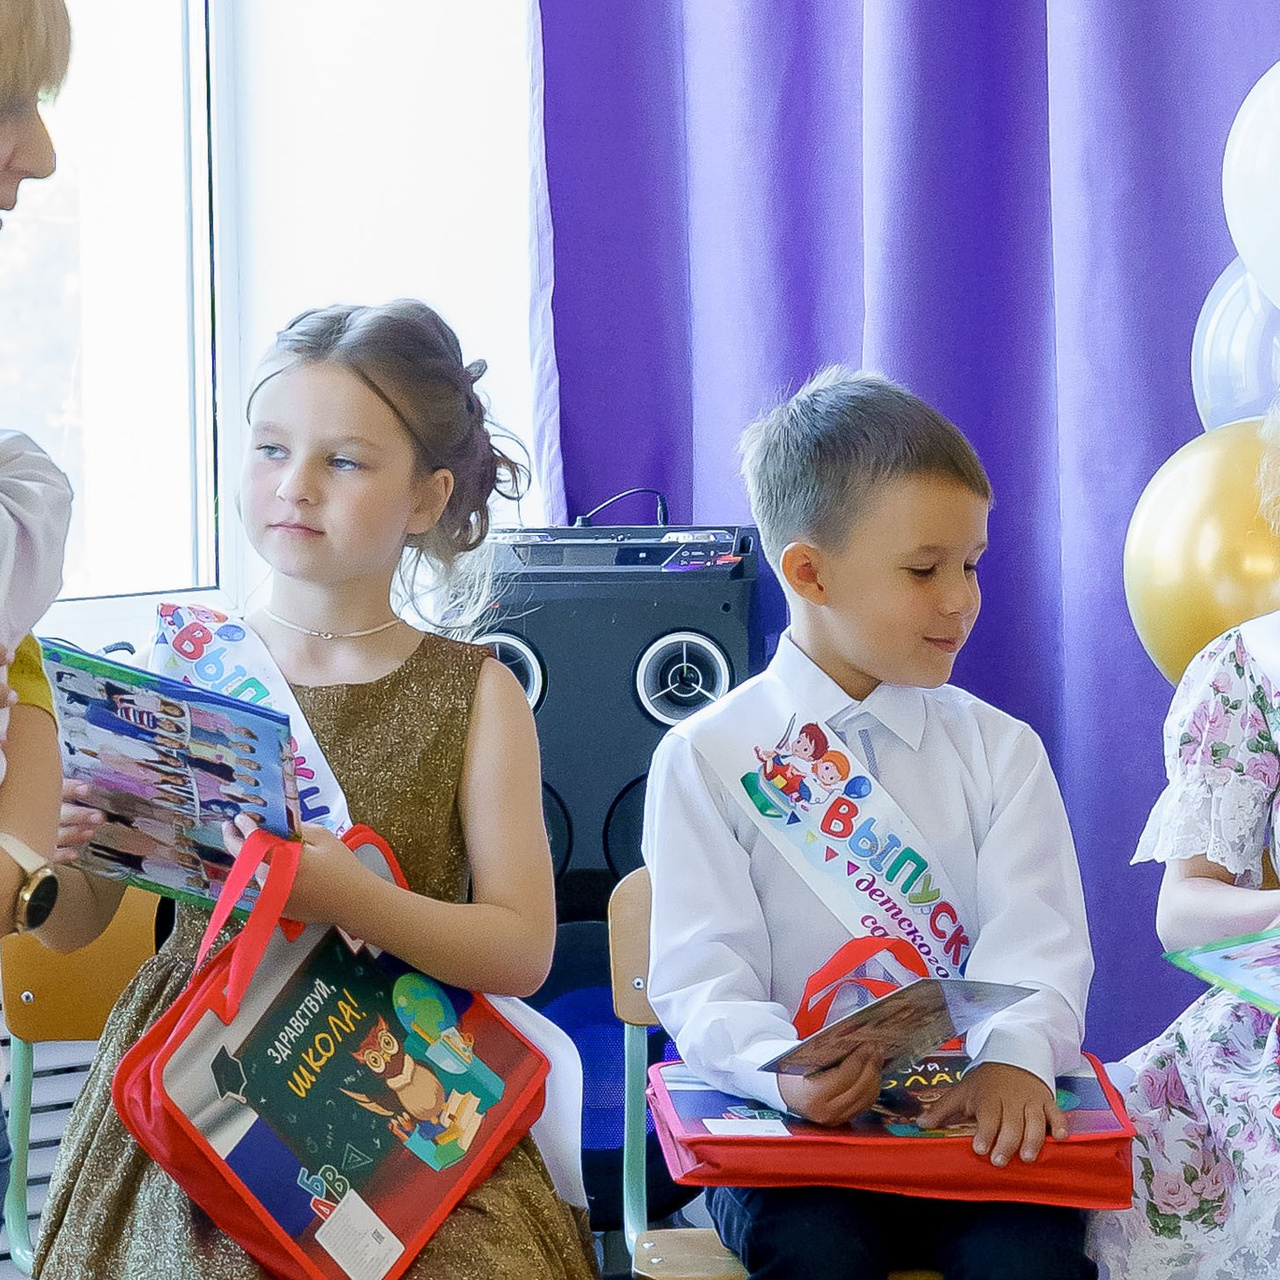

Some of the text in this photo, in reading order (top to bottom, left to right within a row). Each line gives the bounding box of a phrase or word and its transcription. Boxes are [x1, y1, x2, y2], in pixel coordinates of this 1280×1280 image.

[820, 796, 970, 978] ВЫПУСК
[855, 873, 950, 978] детского
[861, 915, 890, 938] са
[267, 978, 337, 1064] ЗДРАВСТВУЙ,
[287, 987, 367, 1098] ШКОЛА!
